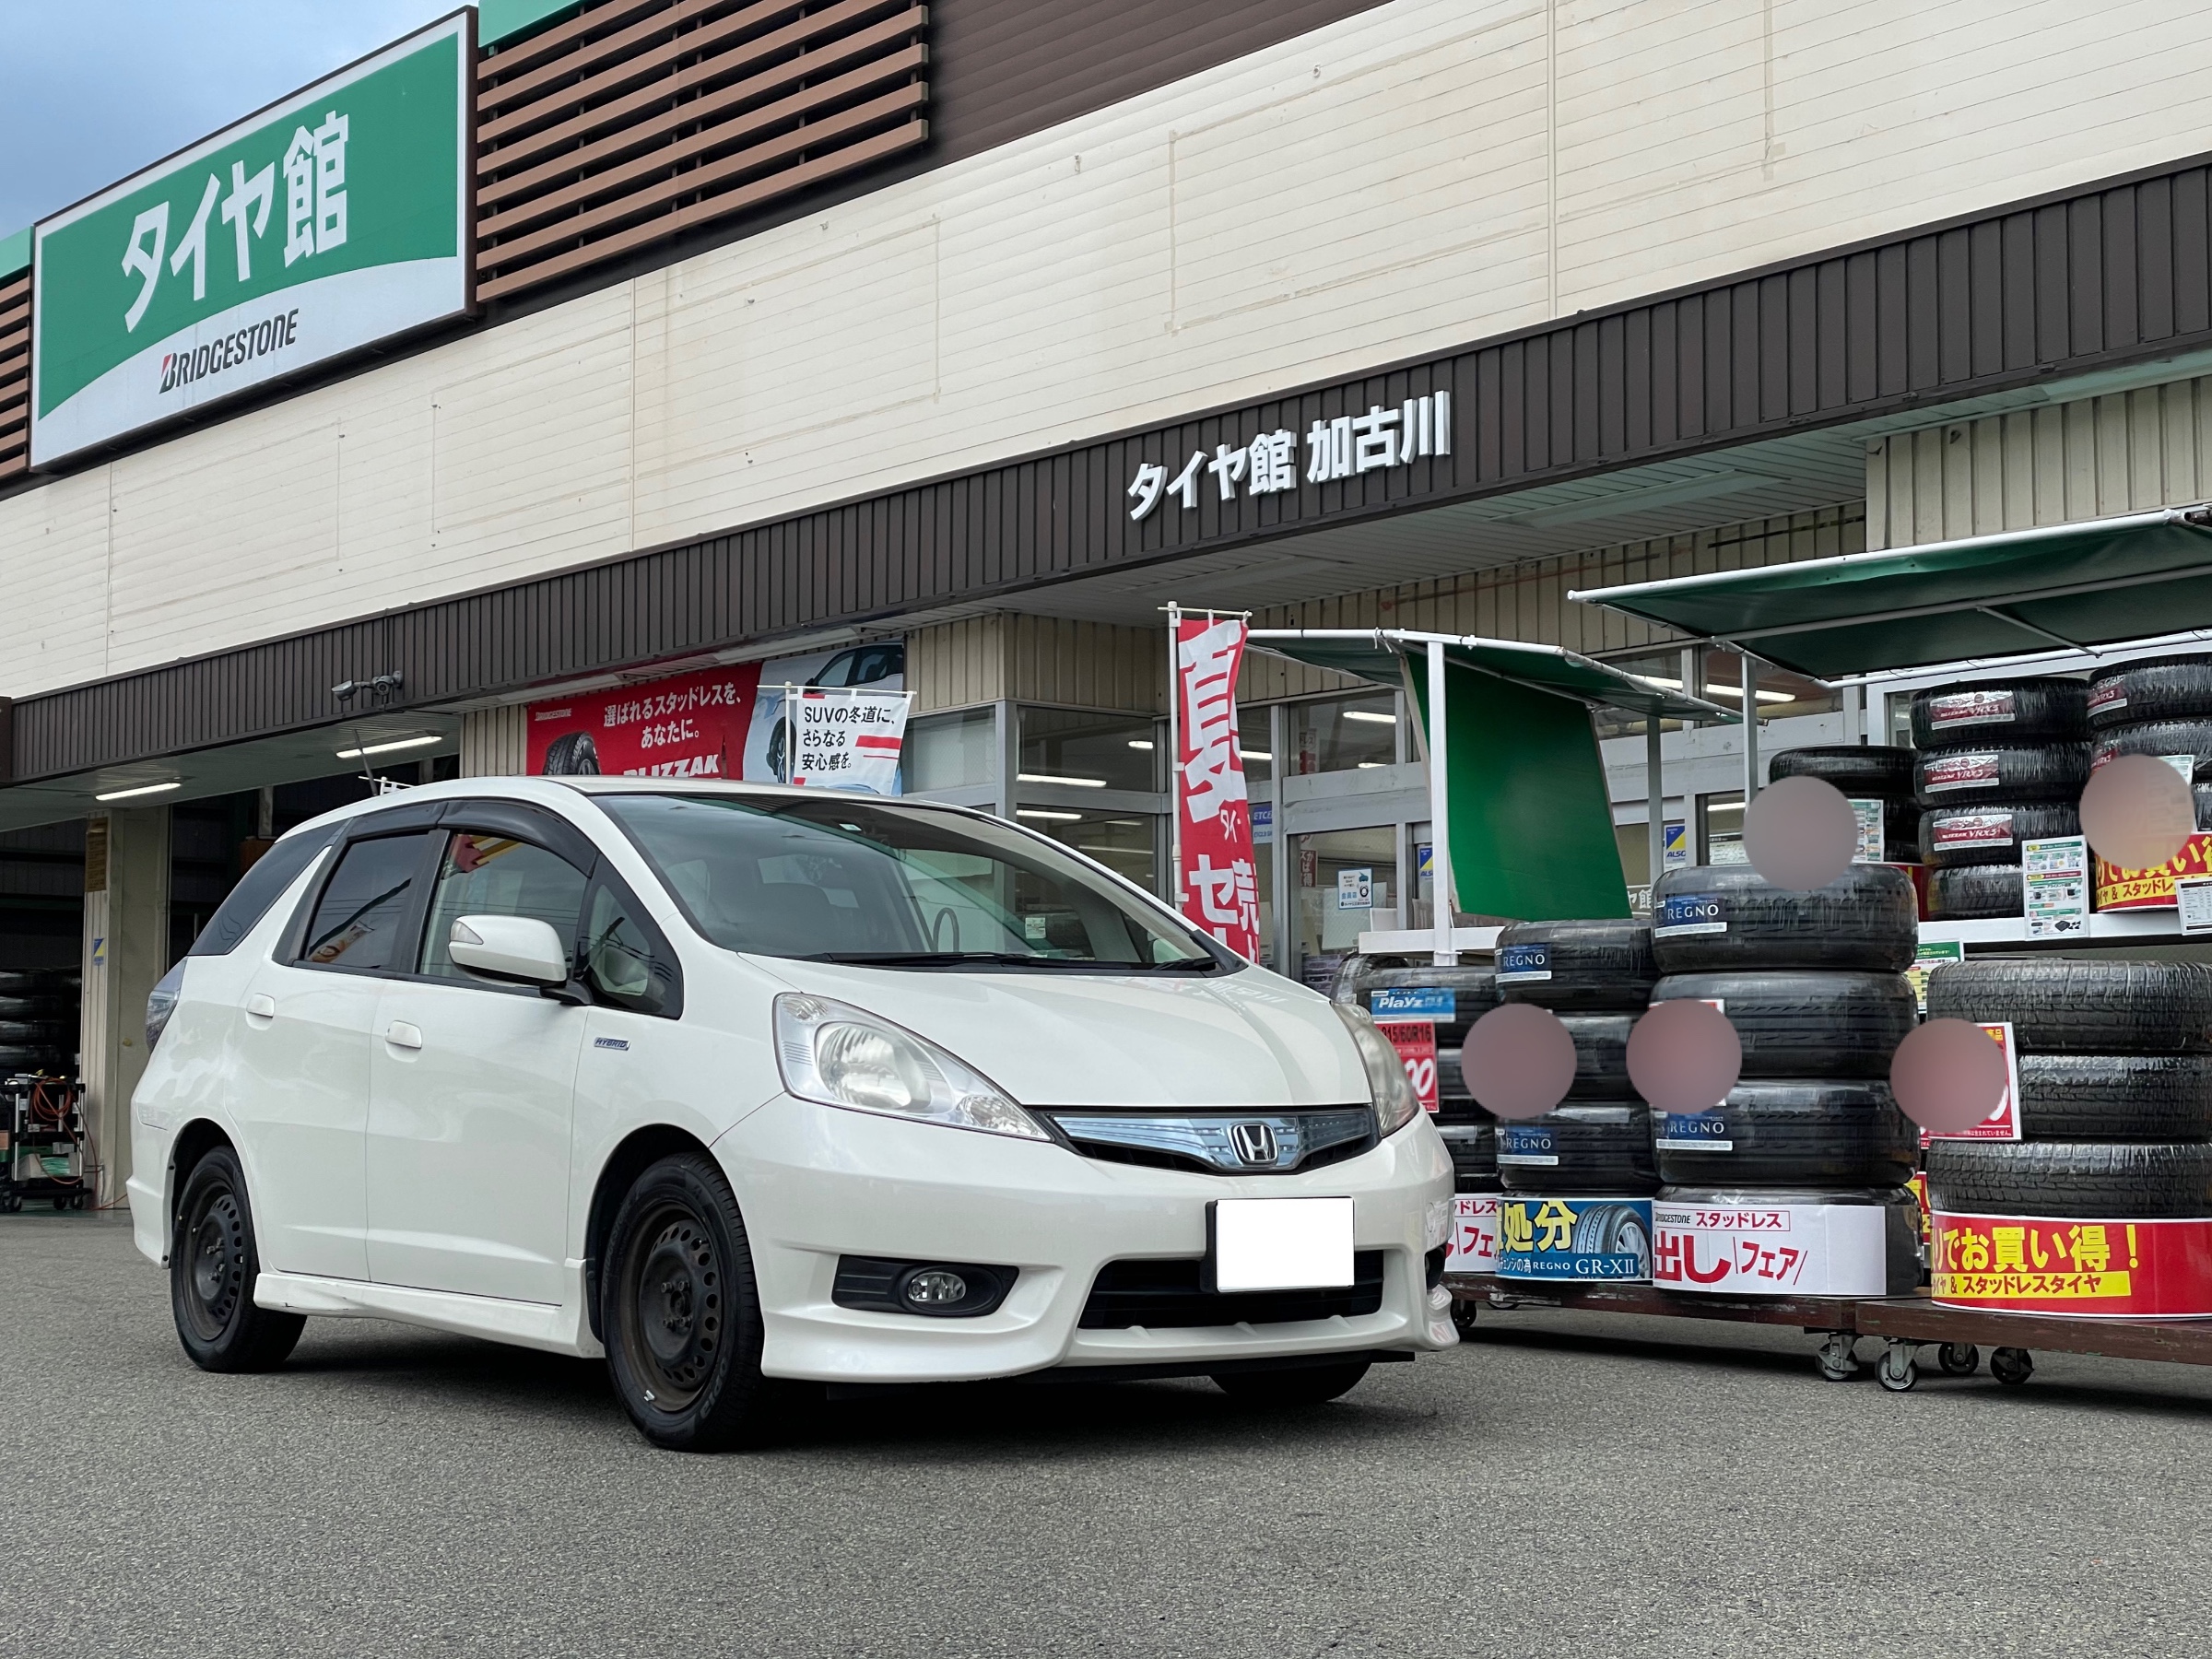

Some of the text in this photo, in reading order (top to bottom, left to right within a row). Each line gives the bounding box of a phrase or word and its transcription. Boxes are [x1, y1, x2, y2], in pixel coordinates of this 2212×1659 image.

[121, 110, 349, 333] タイヤ館
[159, 308, 300, 394] BRIDGESTONE
[1127, 390, 1451, 521] タイヤ館 加古川
[604, 682, 741, 727] 選ばれるスタッドレスを、
[805, 706, 895, 724] SUVの冬道に、
[641, 718, 700, 748] あなたに。
[803, 729, 846, 747] さらなる
[802, 752, 852, 771] 安心感を。
[1969, 830, 1997, 838] VRX3
[1667, 904, 1719, 920] REGNO
[1503, 954, 1546, 967] REGNO
[594, 1039, 628, 1048] HYBRID
[1669, 1120, 1724, 1134] REGNO
[1506, 1137, 1551, 1149] REGNO
[1696, 1211, 1783, 1229] スタッドレス
[1533, 1261, 1571, 1271] REGNO
[1741, 1241, 1800, 1281] フェア
[1950, 1276, 1958, 1294] &
[1963, 1274, 2102, 1295] スタッドレスタイヤ
